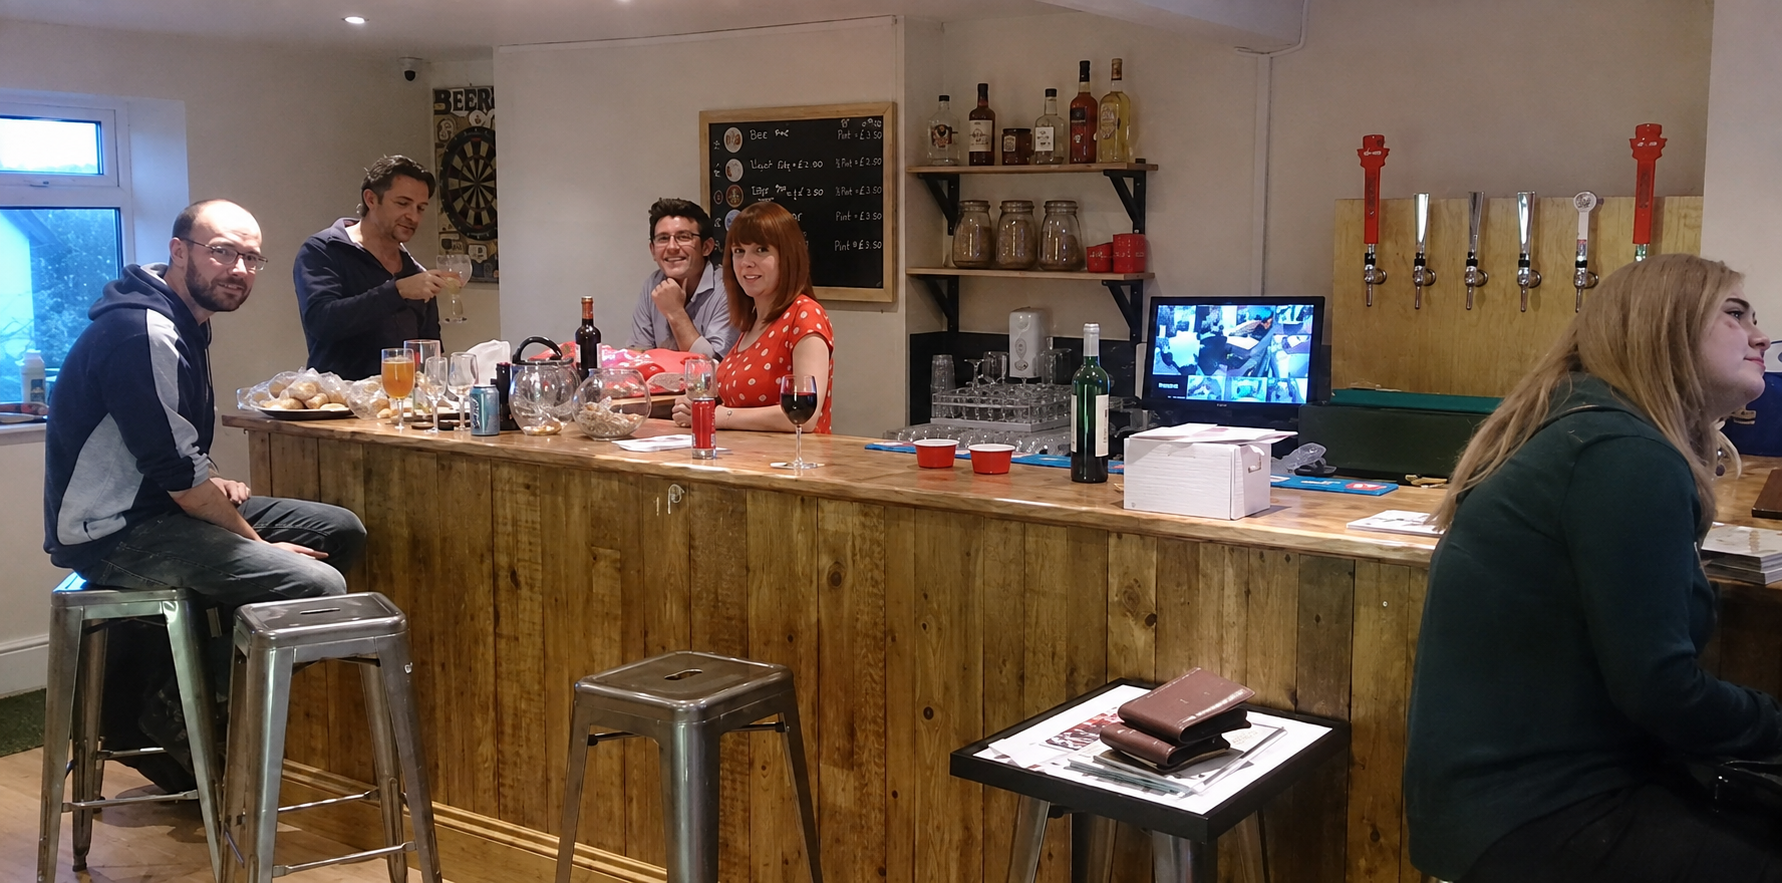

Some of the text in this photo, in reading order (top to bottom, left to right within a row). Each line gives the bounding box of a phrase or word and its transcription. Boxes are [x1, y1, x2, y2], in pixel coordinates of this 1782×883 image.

[434, 88, 492, 115] BEER
[835, 210, 851, 221] Pint
[834, 239, 850, 251] Pint
